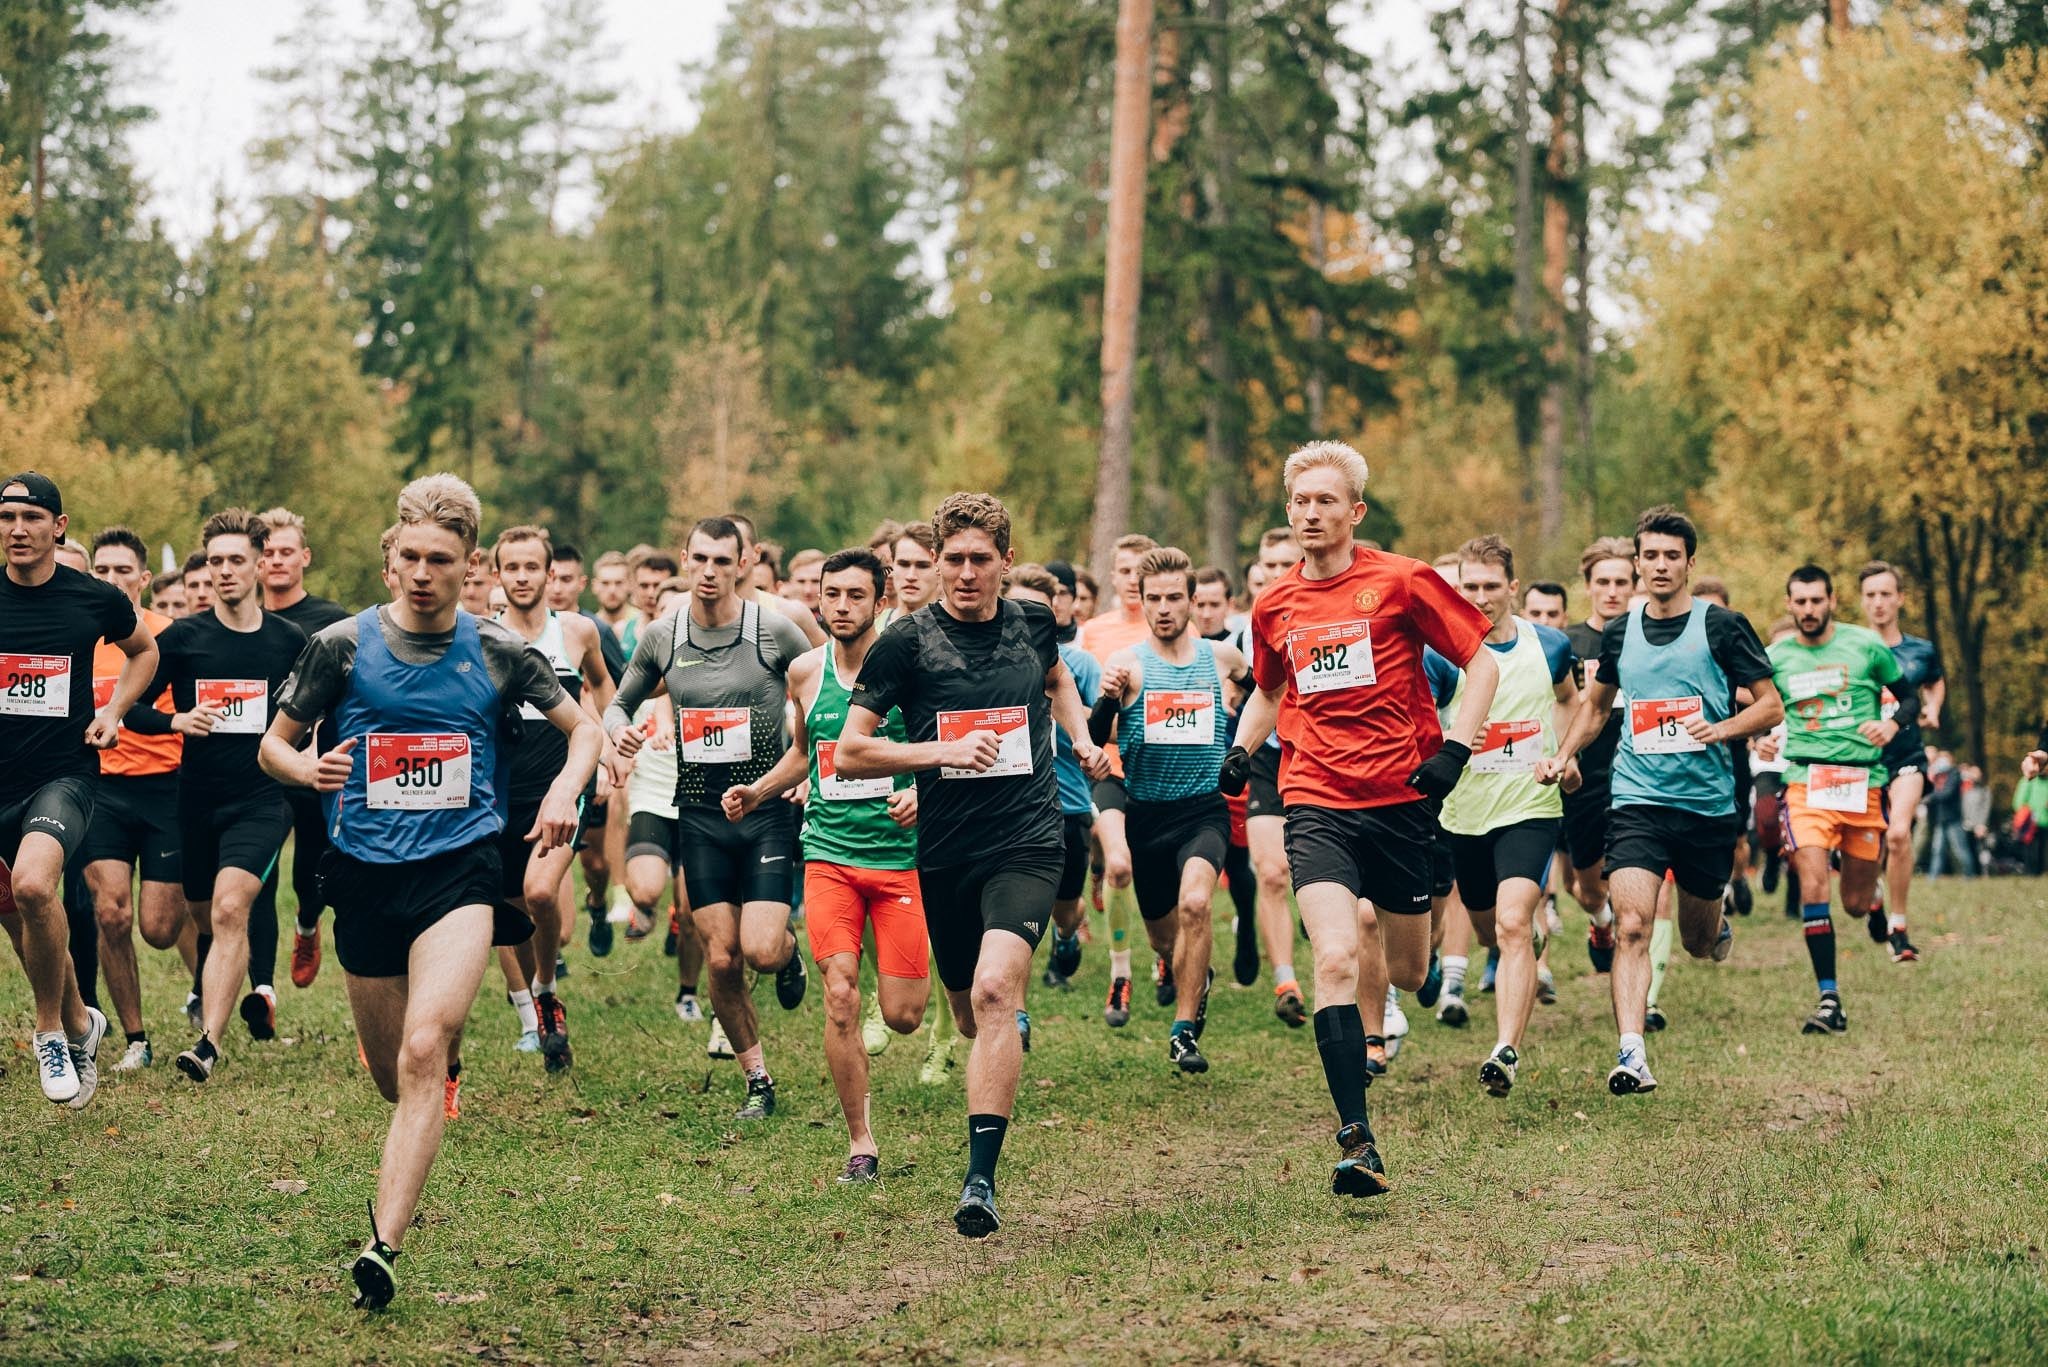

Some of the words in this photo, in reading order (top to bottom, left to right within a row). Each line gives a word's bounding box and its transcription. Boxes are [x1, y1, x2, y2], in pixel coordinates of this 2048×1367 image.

[1310, 643, 1349, 673] 352
[7, 672, 46, 698] 298
[222, 697, 243, 717] 30
[1164, 707, 1197, 728] 294
[703, 725, 723, 747] 80
[1657, 715, 1677, 737] 13
[1503, 737, 1514, 757] 4
[395, 757, 443, 787] 350
